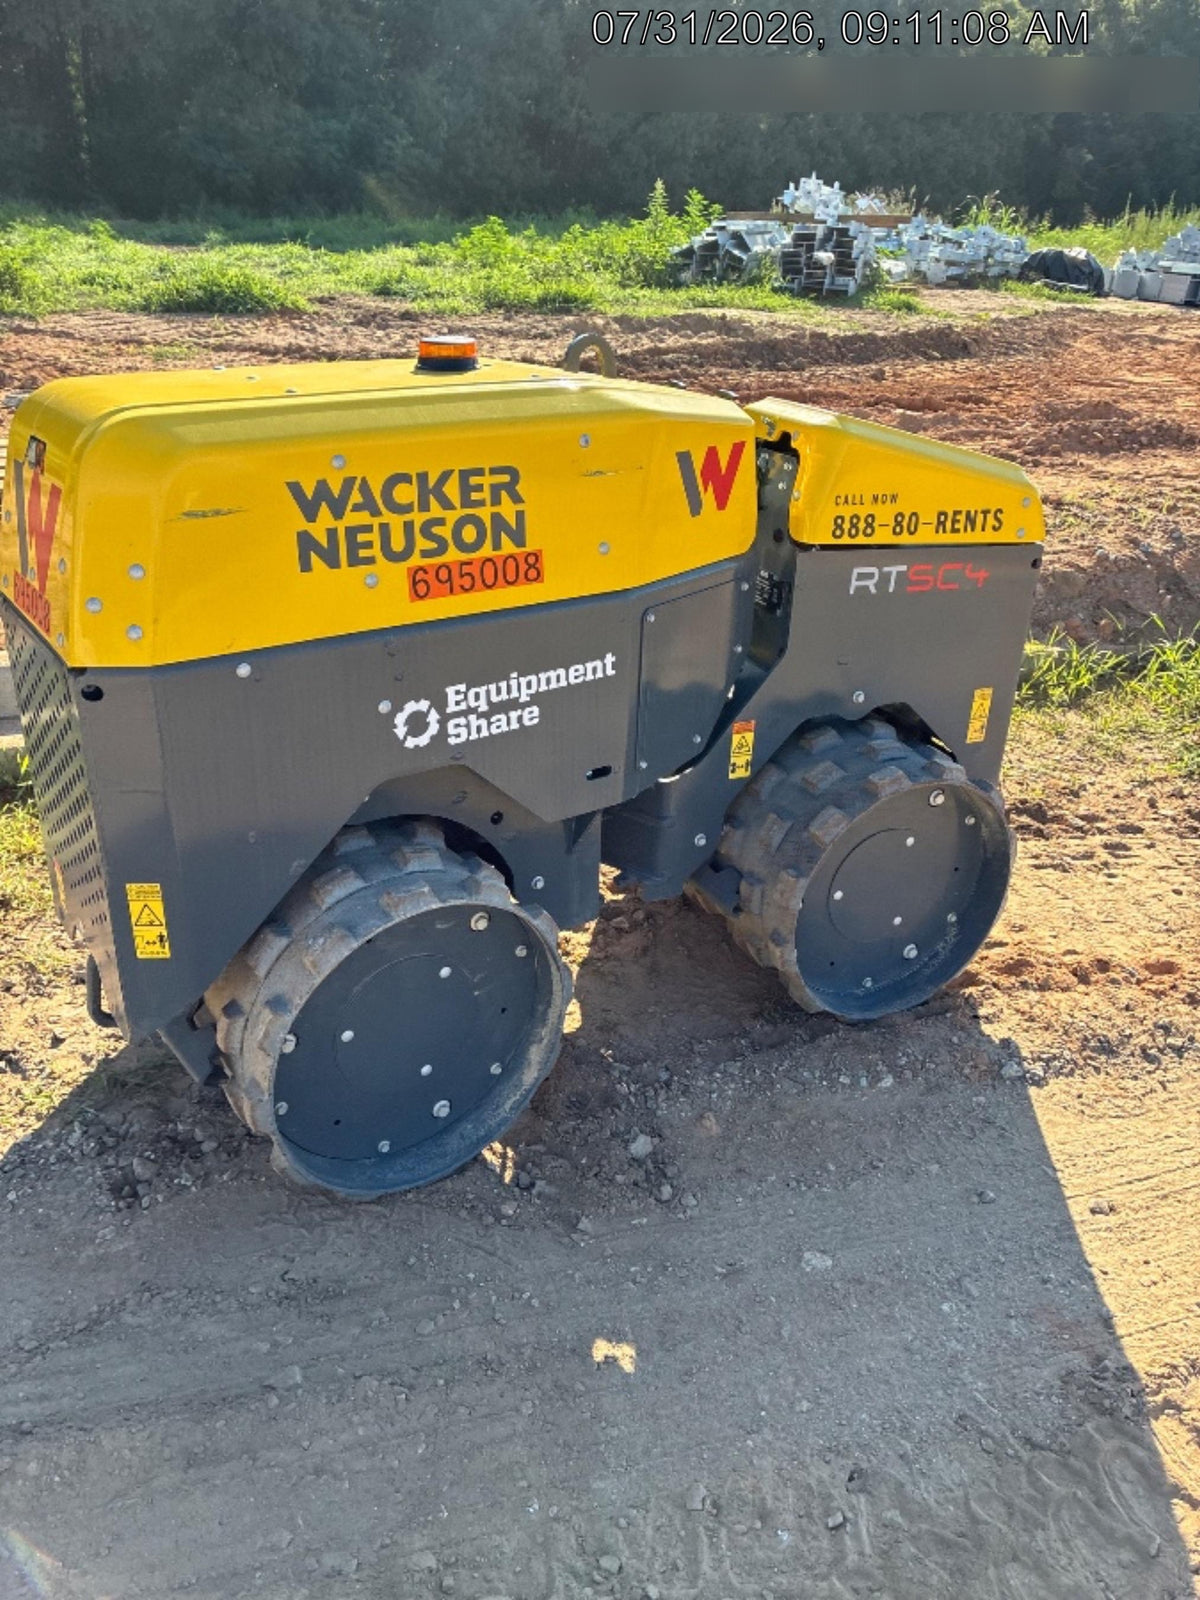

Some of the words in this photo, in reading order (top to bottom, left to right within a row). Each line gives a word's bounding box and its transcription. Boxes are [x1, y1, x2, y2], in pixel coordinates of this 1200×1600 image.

[285, 465, 525, 523] WACKER
[835, 494, 866, 507] CALL
[871, 493, 900, 505] NOW
[296, 510, 527, 572] NEUSON
[832, 508, 1004, 539] 888-80-RENTS
[411, 553, 541, 599] 695008
[445, 652, 617, 713] Equipment
[447, 705, 540, 745] Share
